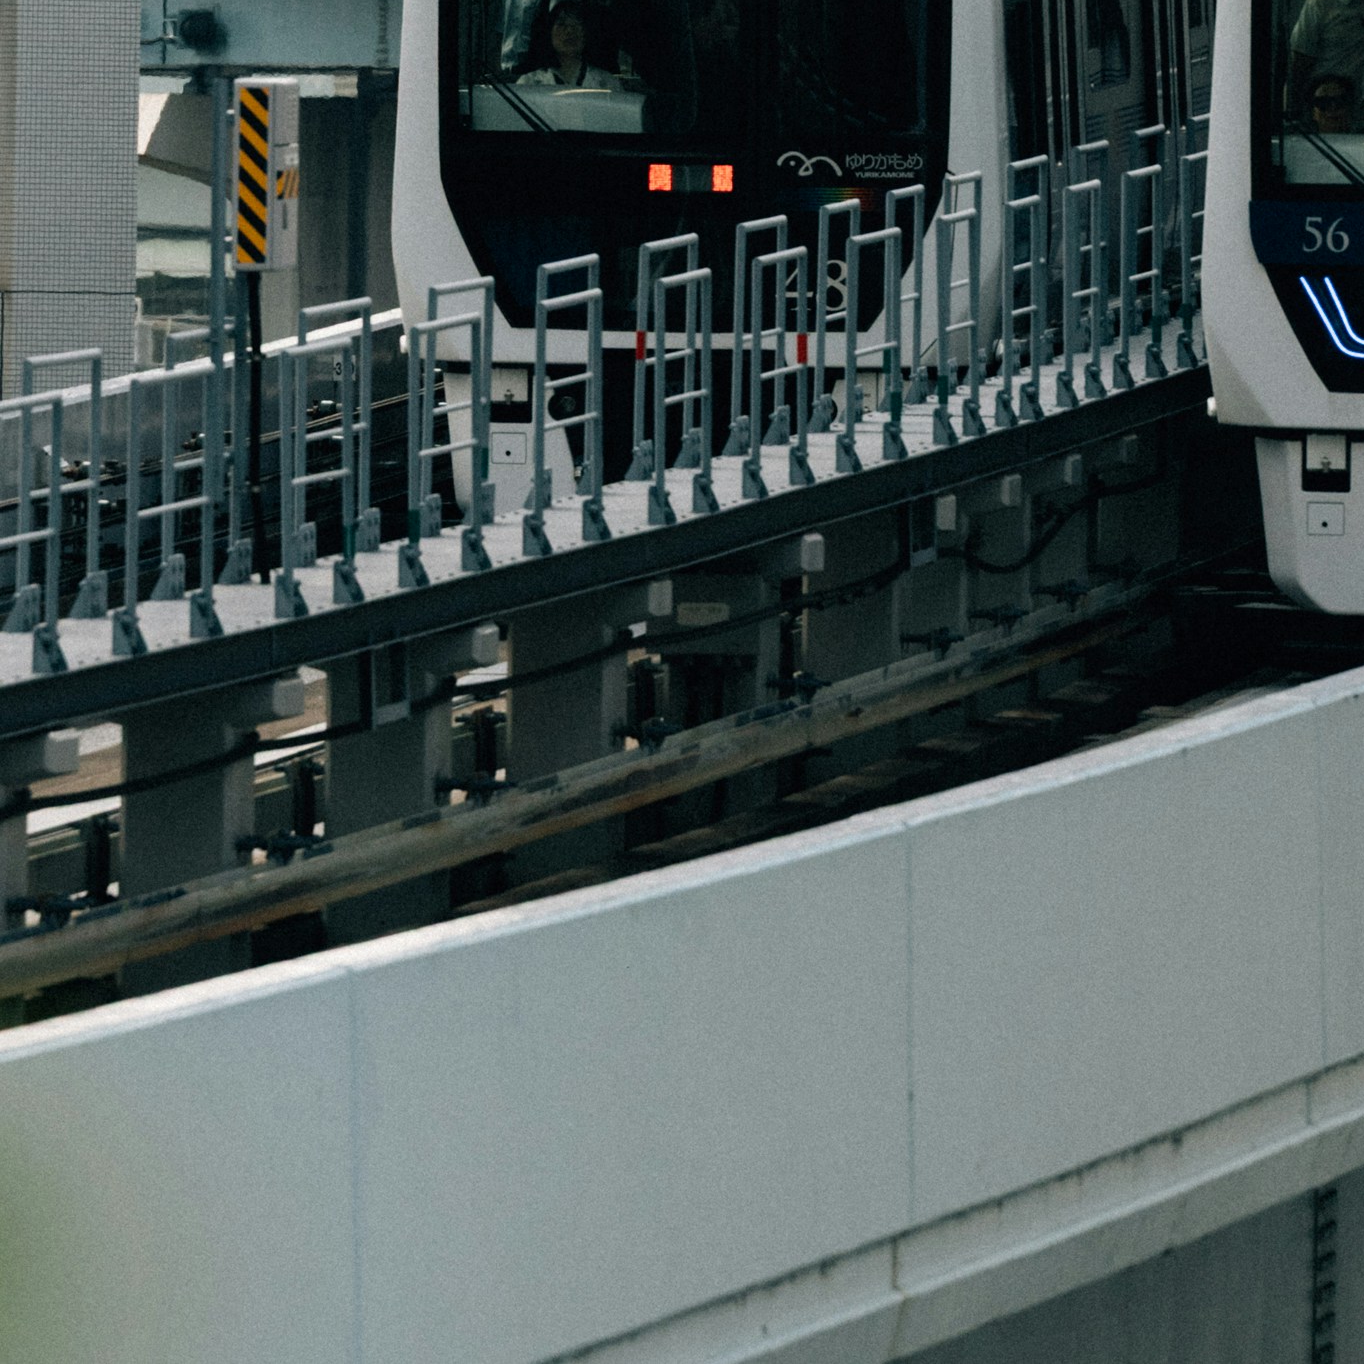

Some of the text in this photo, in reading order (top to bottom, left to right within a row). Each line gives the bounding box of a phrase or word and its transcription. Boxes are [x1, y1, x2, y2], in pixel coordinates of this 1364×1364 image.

[845, 152, 924, 170] ゆりかもめ
[855, 171, 915, 179] YURIKAMOME
[1302, 216, 1350, 253] 56
